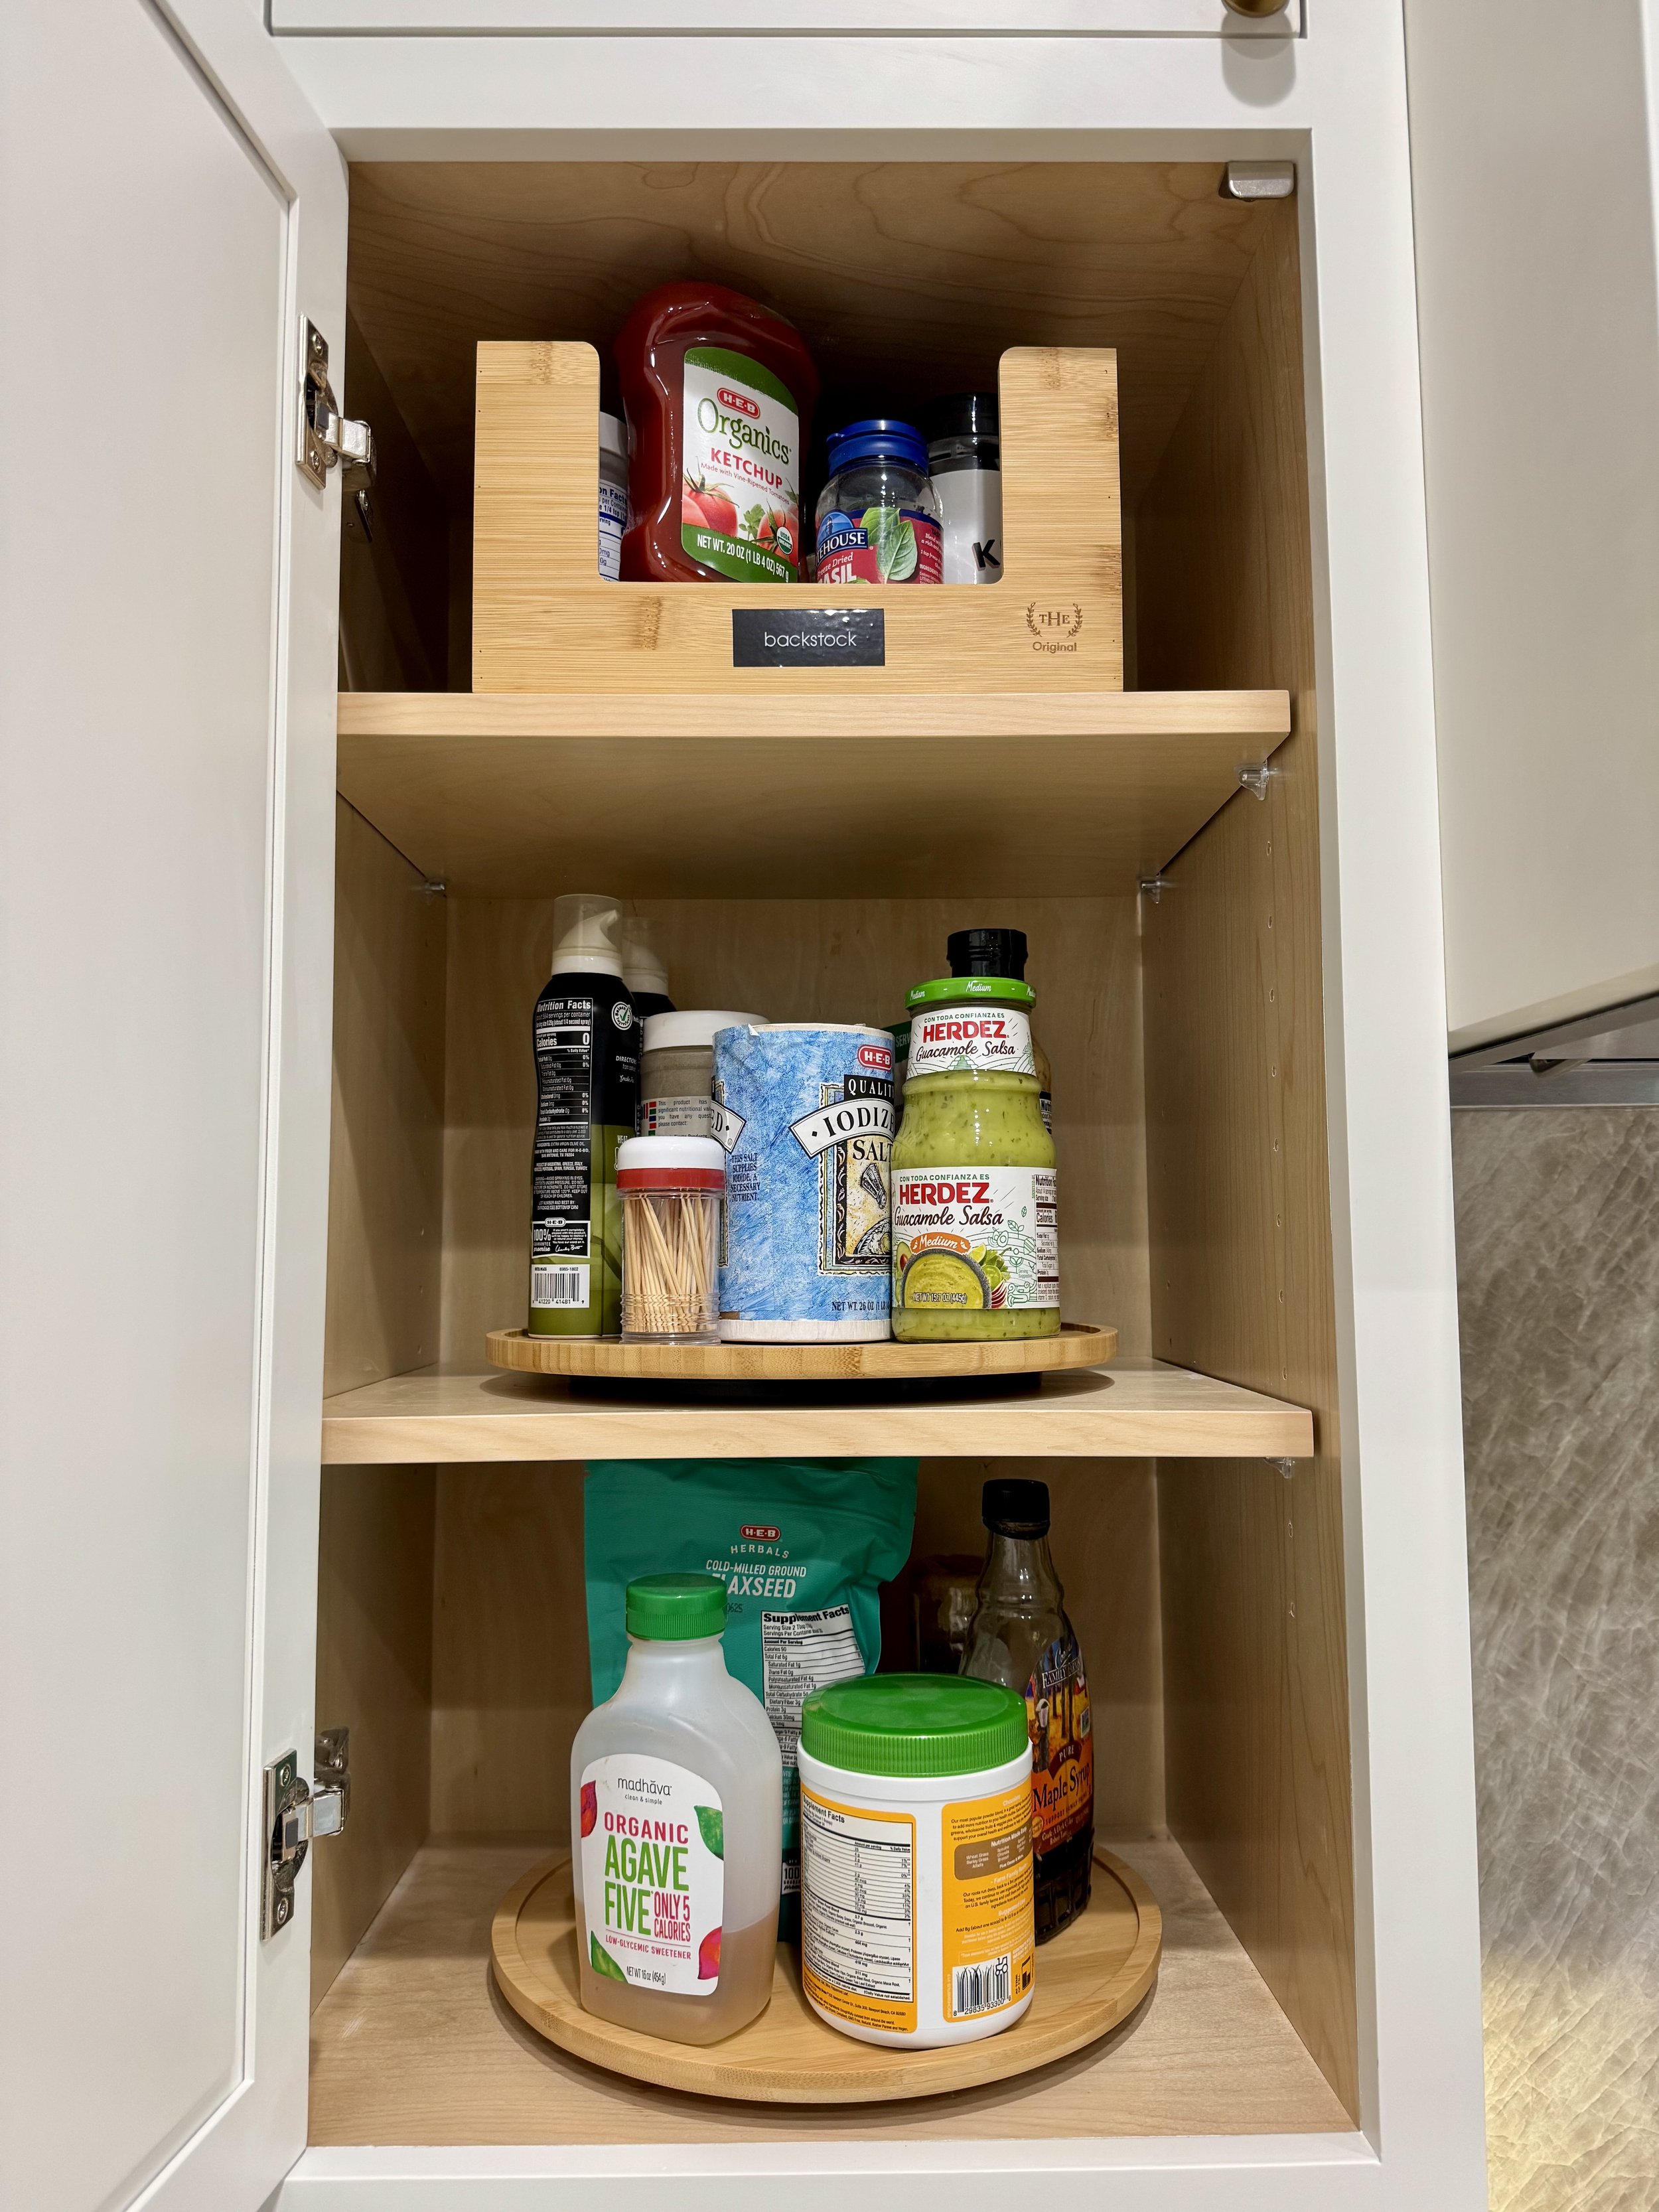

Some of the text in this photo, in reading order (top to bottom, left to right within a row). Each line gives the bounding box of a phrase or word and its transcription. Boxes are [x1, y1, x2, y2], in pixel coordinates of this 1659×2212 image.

[697, 398, 790, 465] Organics
[711, 447, 782, 489] KETCHUP
[701, 463, 790, 505] Made with Vine-Ripened Tomatoes
[697, 534, 790, 583] NET WT. 20 OZ (1 LB 4 OZ) 567 g
[832, 552, 853, 567] Dried
[818, 563, 857, 584] ASIL
[1039, 611, 1070, 626] THE
[764, 631, 857, 648] backstock
[1033, 641, 1077, 654] Original
[910, 990, 925, 1000] Medium
[965, 981, 992, 993] Medium
[567, 1000, 591, 1009] Facts
[537, 1032, 590, 1048] Calories 0
[923, 1020, 1007, 1043] HERDEZ
[916, 1039, 1015, 1063] Guacamole Salsa
[823, 1106, 895, 1138] IODIZE
[731, 1153, 758, 1163] THIS SALT
[852, 1139, 893, 1163] SALT
[733, 1163, 757, 1173] SUPPLIES
[733, 1173, 752, 1183] IODIDE,
[731, 1181, 760, 1194] NECESSARY
[899, 1182, 990, 1206] HERDEZ
[895, 1205, 1004, 1226] Guacamole Salsa
[1036, 1212, 1053, 1224] Calories
[534, 1228, 551, 1241] 100%
[919, 1234, 959, 1250] Medium
[831, 1301, 845, 1311] NET
[847, 1301, 857, 1311] WT.
[859, 1301, 866, 1311] 26
[867, 1301, 874, 1311] OZ
[922, 1292, 930, 1302] WT
[930, 1292, 942, 1302] 15.7
[942, 1292, 950, 1302] OZ
[950, 1291, 967, 1304] (445g)
[731, 1544, 790, 1560] HERBALS
[705, 1559, 807, 1578] COLD-MILLED GROUND
[763, 1606, 850, 1625] Supplement Facts
[1042, 1668, 1066, 1689] FAMILY
[1059, 1744, 1075, 1763] PURE
[1033, 1762, 1090, 1812] Maple Syrup
[828, 1810, 845, 1823] Facts
[1045, 1808, 1065, 1825] SUPPORT
[604, 1811, 689, 1844] ORGANIC
[991, 1836, 1011, 1848] Nutrition
[605, 1834, 689, 1891] AGAVE
[605, 1880, 690, 1936] FIVE ONLY 5
[654, 1918, 691, 1942] CALORIES
[605, 1934, 691, 1960] LOW-GLYCEMIC SWEETENER
[634, 1967, 641, 1978] WT
[642, 1969, 646, 1979] 16
[646, 1972, 651, 1980] oz
[964, 2004, 985, 2016] 29835
[986, 1997, 1005, 2010] 93300
